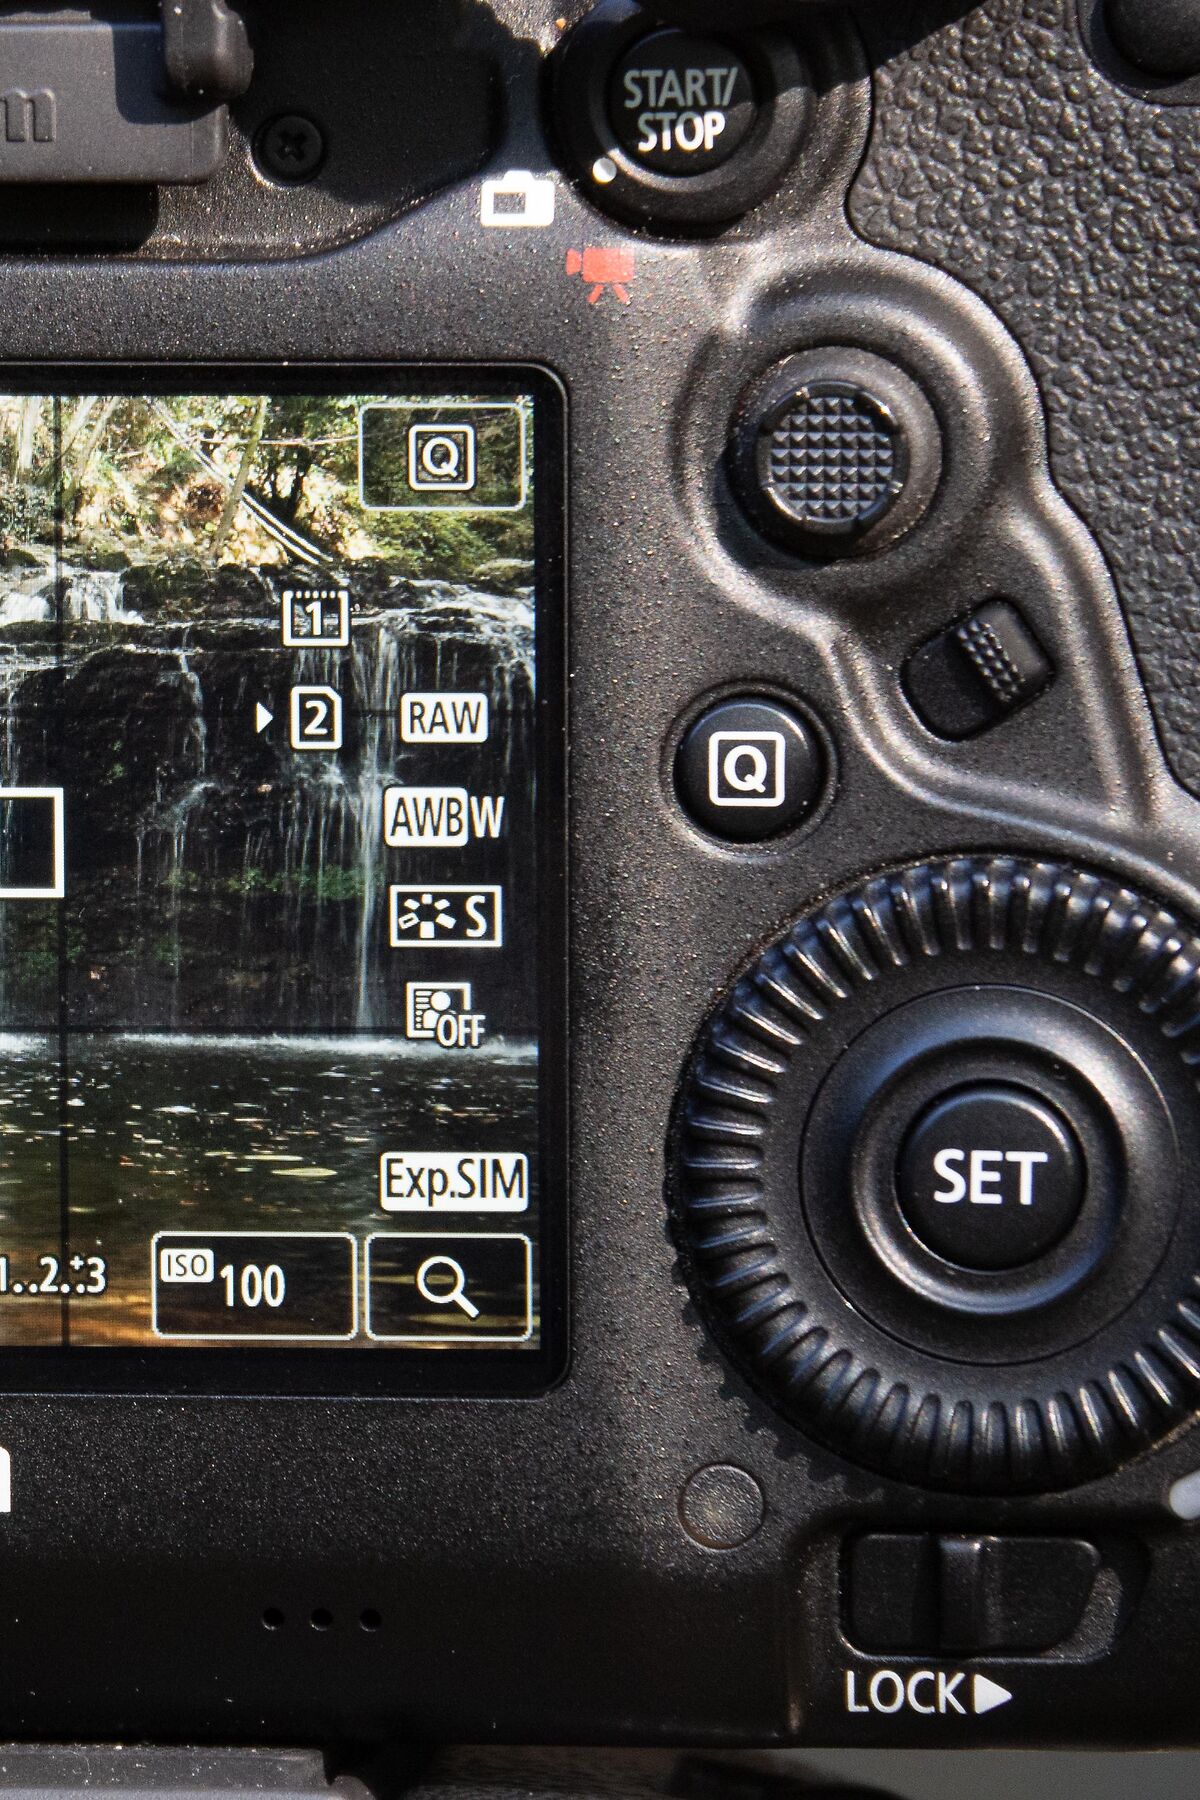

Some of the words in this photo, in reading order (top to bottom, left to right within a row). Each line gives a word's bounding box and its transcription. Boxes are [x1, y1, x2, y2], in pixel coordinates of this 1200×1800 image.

[623, 66, 738, 109] START/
[637, 111, 726, 152] STOP
[422, 436, 459, 478] Q
[304, 600, 322, 636] 1
[304, 700, 328, 735] 2
[409, 701, 481, 734] RAW
[723, 744, 768, 793] Q
[465, 895, 487, 938] S
[438, 1014, 486, 1046] OFF
[385, 1157, 525, 1206] Exp.SIM
[932, 1150, 1048, 1205] SET
[167, 1254, 208, 1276] ISO
[220, 1264, 286, 1308] 100
[846, 1669, 967, 1714] LOCK
